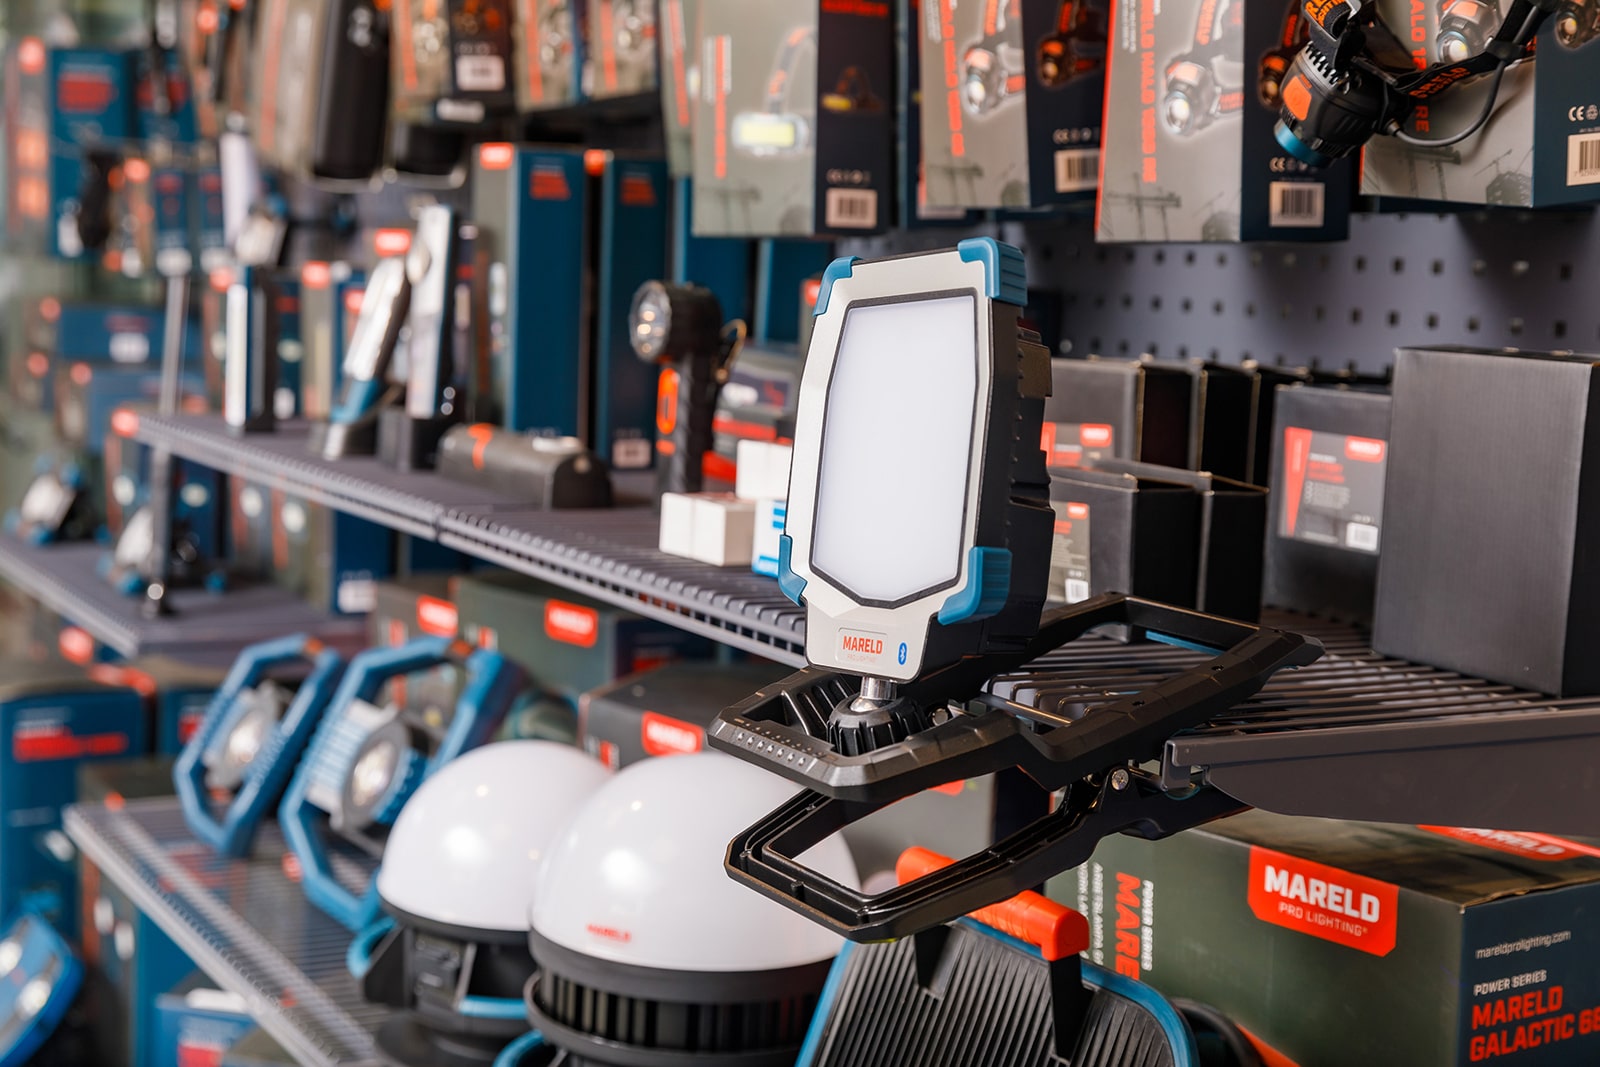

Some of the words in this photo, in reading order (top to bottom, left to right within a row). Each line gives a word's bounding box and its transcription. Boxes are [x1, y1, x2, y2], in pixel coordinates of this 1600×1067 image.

[1410, 0, 1427, 43] ALO
[843, 635, 883, 655] MARELD
[1263, 865, 1380, 924] MARELD
[1279, 901, 1304, 920] PRO
[1115, 872, 1141, 980] MARE
[1475, 931, 1571, 959] mareldprolighting.com
[1473, 977, 1511, 996] POWER
[1511, 969, 1547, 988] SERIES
[1472, 986, 1563, 1030] MARELD
[1470, 1014, 1575, 1061] GALACTIC
